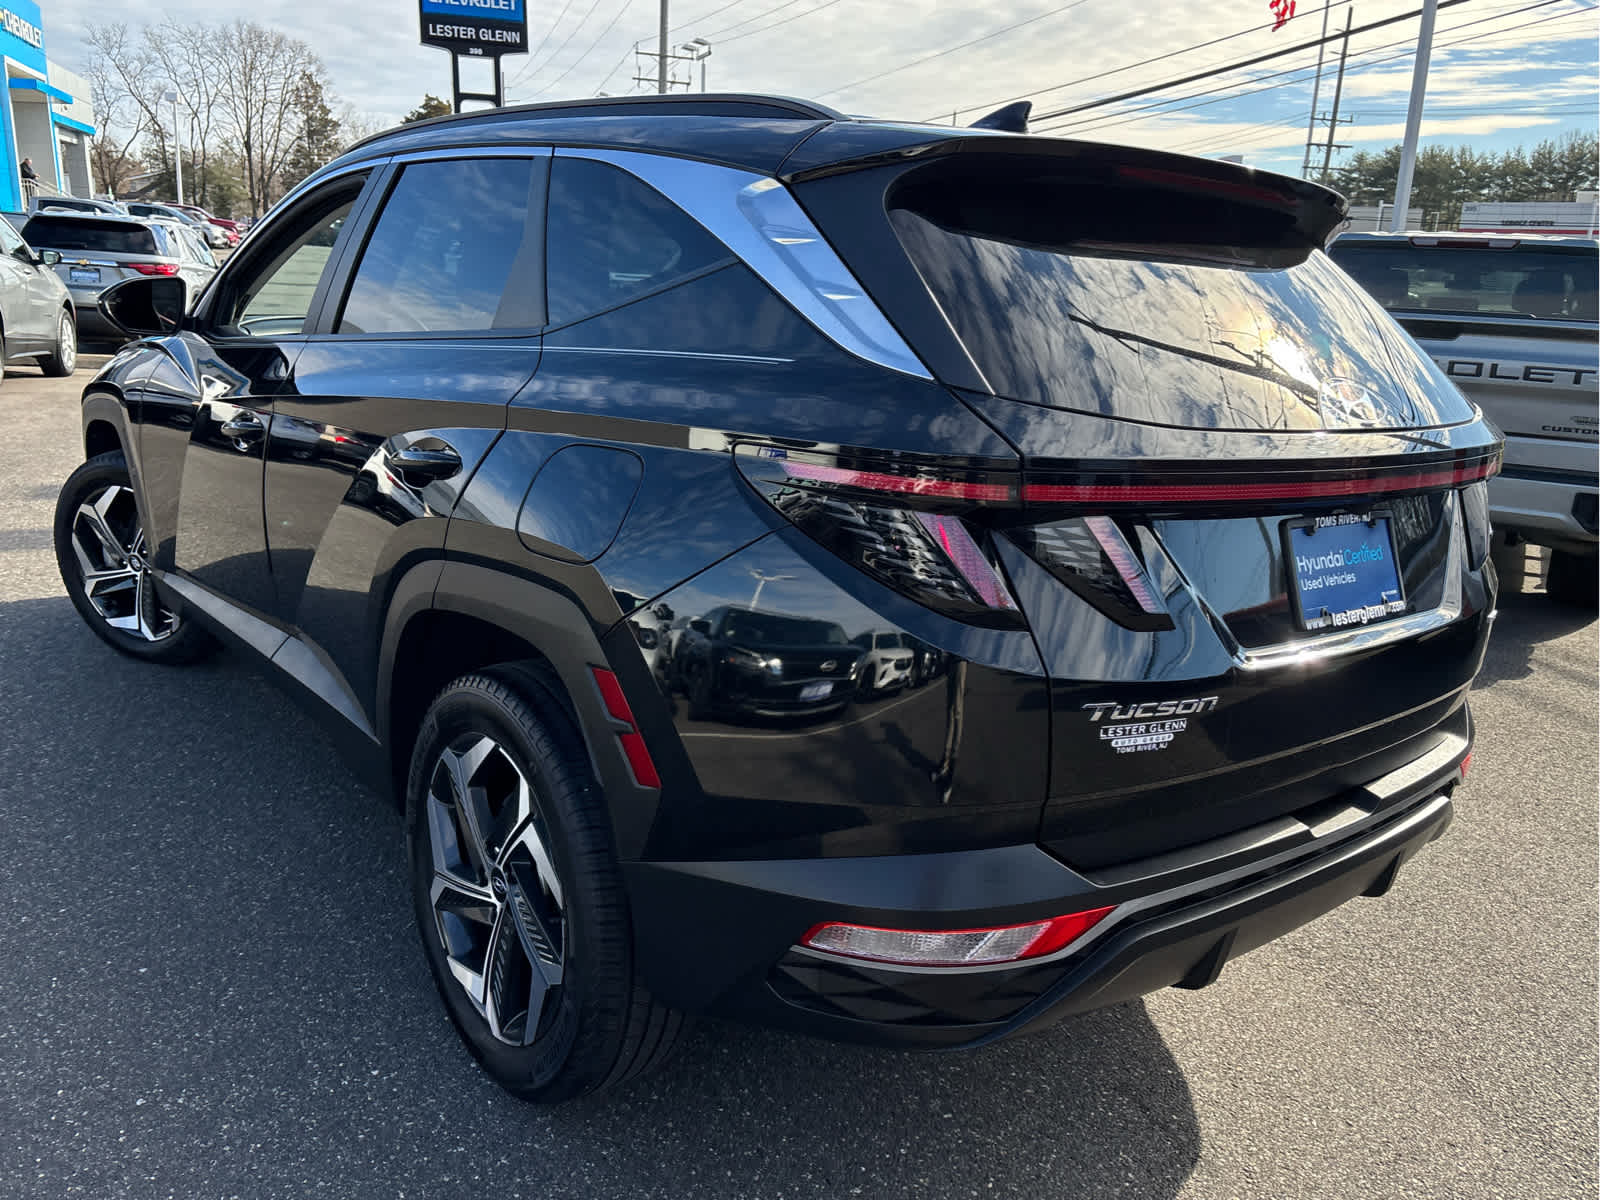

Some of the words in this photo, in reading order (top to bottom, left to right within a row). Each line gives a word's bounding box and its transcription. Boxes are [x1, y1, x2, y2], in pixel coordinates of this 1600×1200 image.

[428, 0, 516, 11] VROLET
[428, 23, 476, 39] LESTER
[479, 28, 520, 43] GLENN
[1434, 359, 1596, 385] OLET
[1314, 515, 1337, 528] TOMS
[1301, 576, 1323, 591] Used
[1323, 571, 1357, 587] Vehicles
[1100, 725, 1146, 737] LESTER
[1149, 720, 1187, 733] GLENN
[1142, 734, 1172, 743] GROUP
[1116, 746, 1136, 754] TOMS
